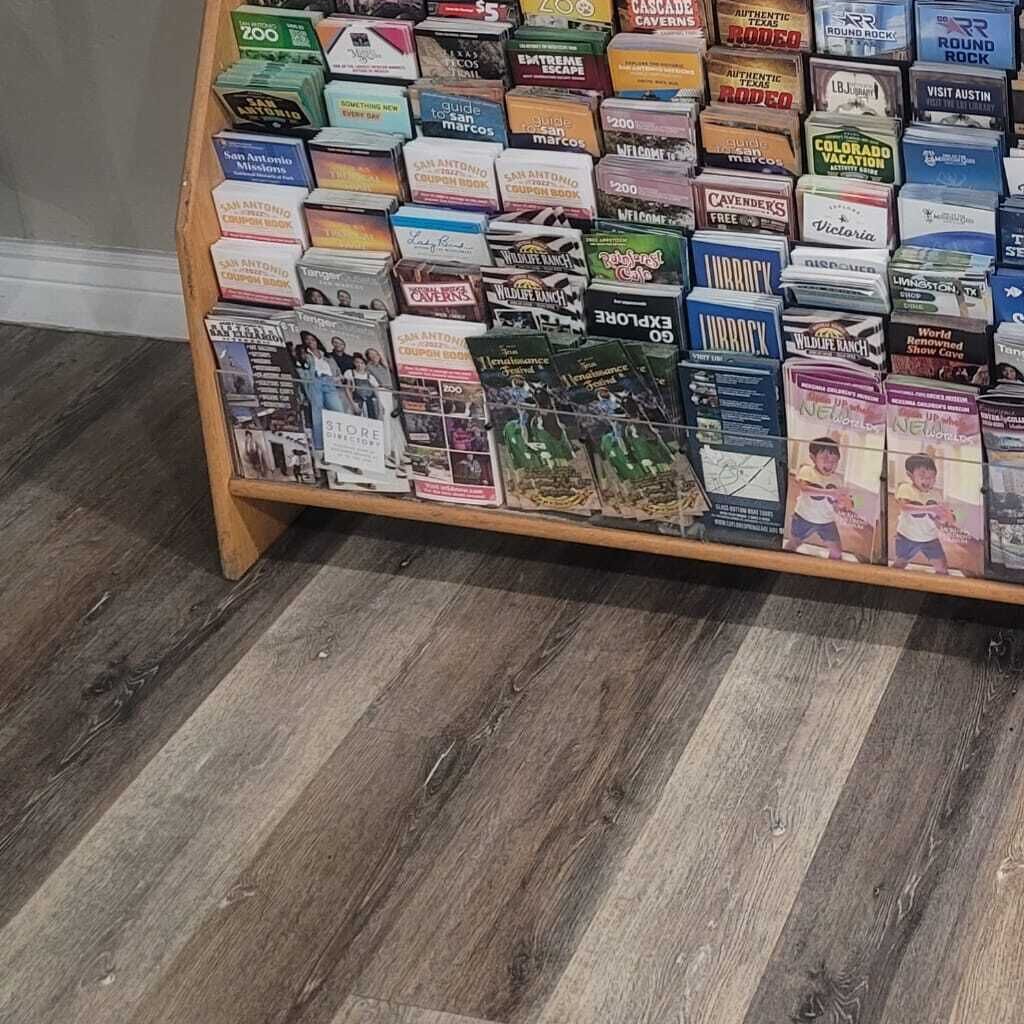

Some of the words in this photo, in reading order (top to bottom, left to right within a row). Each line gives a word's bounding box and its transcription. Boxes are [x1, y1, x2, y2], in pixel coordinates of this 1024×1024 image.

[635, 16, 696, 27] CAVERNS
[734, 9, 790, 21] AUTHENTIC
[747, 17, 778, 27] TEXAS
[241, 26, 279, 42] ZOO
[726, 25, 802, 49] RODEO
[827, 26, 862, 37] ROUND
[864, 30, 893, 40] ROCK
[938, 36, 995, 51] ROUND
[944, 50, 989, 65] ROCK
[541, 65, 585, 75] ESCAPE
[725, 69, 782, 83] AUTHENTIC
[740, 78, 770, 88] TEXAS
[831, 79, 849, 94] LBJ
[718, 85, 794, 110] RODEO
[927, 85, 952, 98] VISIT
[954, 88, 991, 101] AUSTIN
[249, 97, 276, 109] SAN
[340, 100, 380, 110] SOMETHING
[382, 102, 399, 112] NEW
[441, 101, 481, 113] guide
[342, 110, 364, 119] EVERY
[366, 112, 381, 121] DAY
[431, 106, 446, 118] to
[449, 112, 474, 123] san
[442, 120, 494, 136] marcos
[606, 116, 635, 129] $200
[532, 134, 586, 148] marcos
[735, 147, 761, 156] san
[814, 138, 891, 159] COLORADO
[223, 150, 245, 161] San
[247, 152, 293, 165] Antonio
[822, 152, 885, 168] VACATION
[236, 162, 287, 174] Missions
[413, 173, 456, 186] COUPON
[458, 178, 489, 189] BOOK
[609, 180, 637, 194] $200
[505, 185, 549, 196] COUPON
[551, 188, 581, 199] BOOK
[708, 191, 785, 217] CAVENDER'S
[710, 212, 739, 225] FREE
[811, 219, 876, 243] Victoria
[411, 290, 473, 303] CAVERNS
[963, 287, 978, 298] TX
[595, 310, 673, 329] EXPLORE
[917, 327, 951, 339] World
[793, 333, 835, 352] WILDLIFE
[836, 337, 869, 357] RANCH
[906, 336, 964, 351] Renowned
[399, 347, 439, 358] COUPON
[906, 344, 936, 355] Show
[938, 347, 965, 360] Cave
[326, 419, 380, 440] STORE
